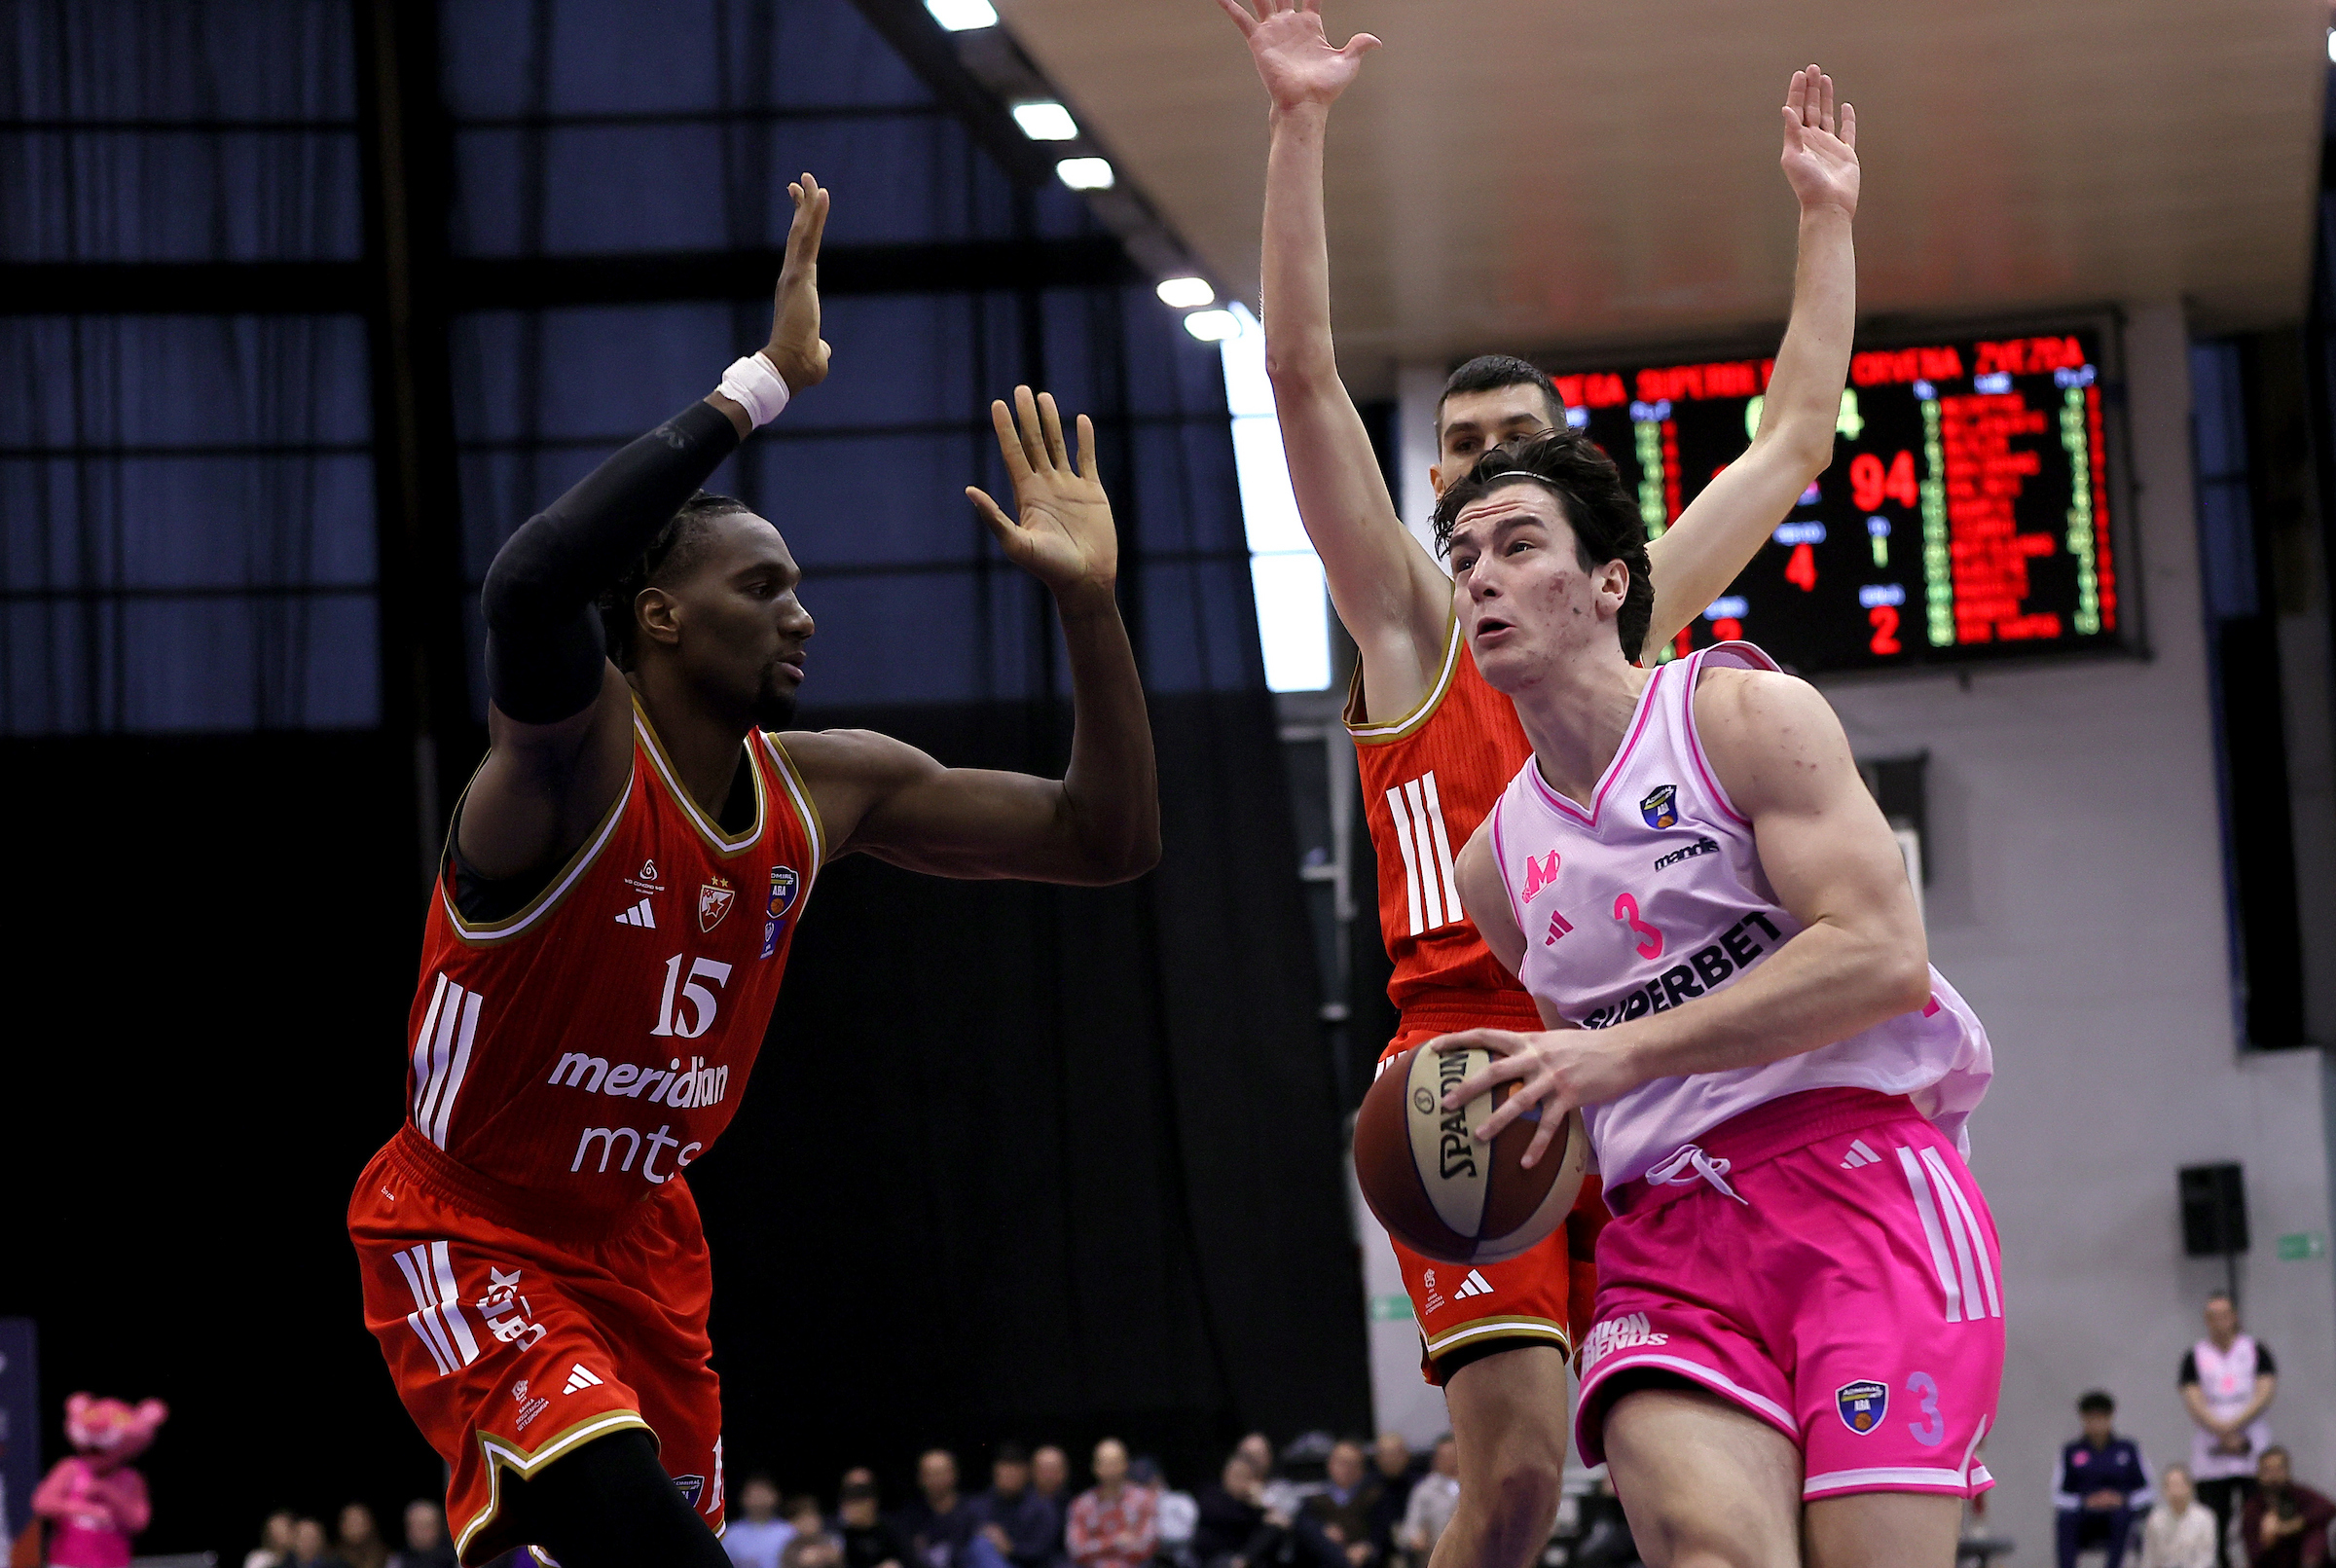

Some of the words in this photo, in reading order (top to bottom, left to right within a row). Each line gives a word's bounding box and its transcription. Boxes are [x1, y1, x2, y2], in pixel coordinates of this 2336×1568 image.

[1850, 450, 1918, 511] 94
[1785, 543, 1818, 592] 4
[1869, 605, 1901, 654] 2
[772, 885, 786, 896] ABA
[1614, 893, 1663, 961] 3
[649, 952, 733, 1039] 15
[1582, 910, 1782, 1030] SUPERBET
[547, 1052, 729, 1109] meridian
[1906, 1371, 1944, 1446] 3
[705, 1435, 724, 1514] 1
